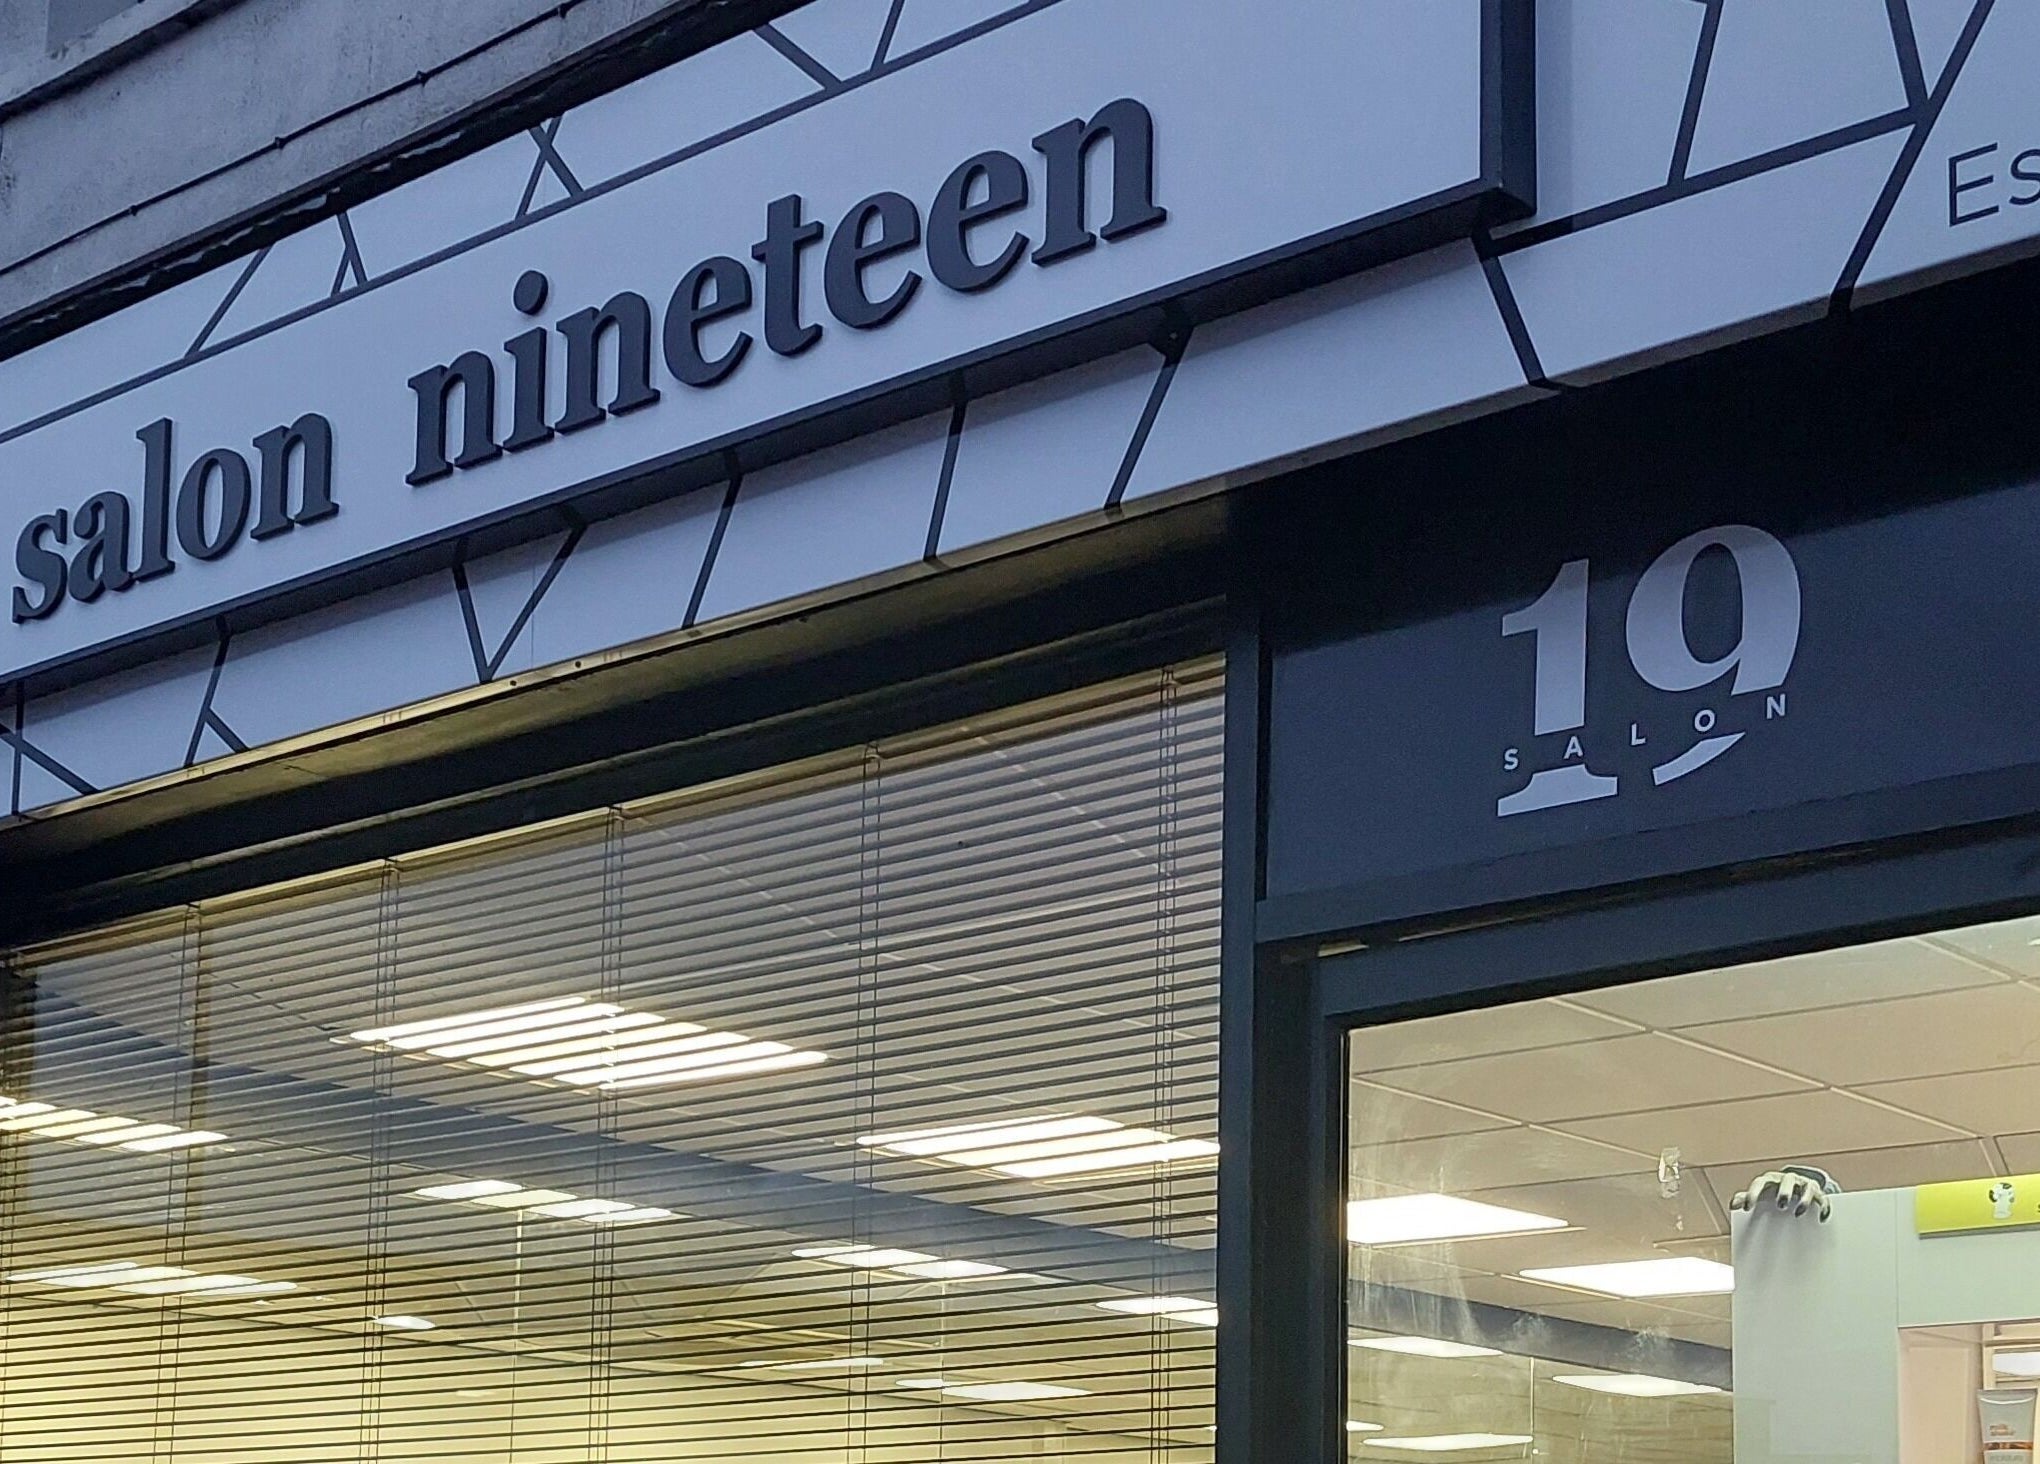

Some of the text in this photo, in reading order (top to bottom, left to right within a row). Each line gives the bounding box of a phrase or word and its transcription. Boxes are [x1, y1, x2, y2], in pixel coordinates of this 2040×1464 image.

[12, 97, 1167, 625] salon nineteen
[1498, 524, 1801, 817] 19
[1504, 694, 1787, 770] SALON
